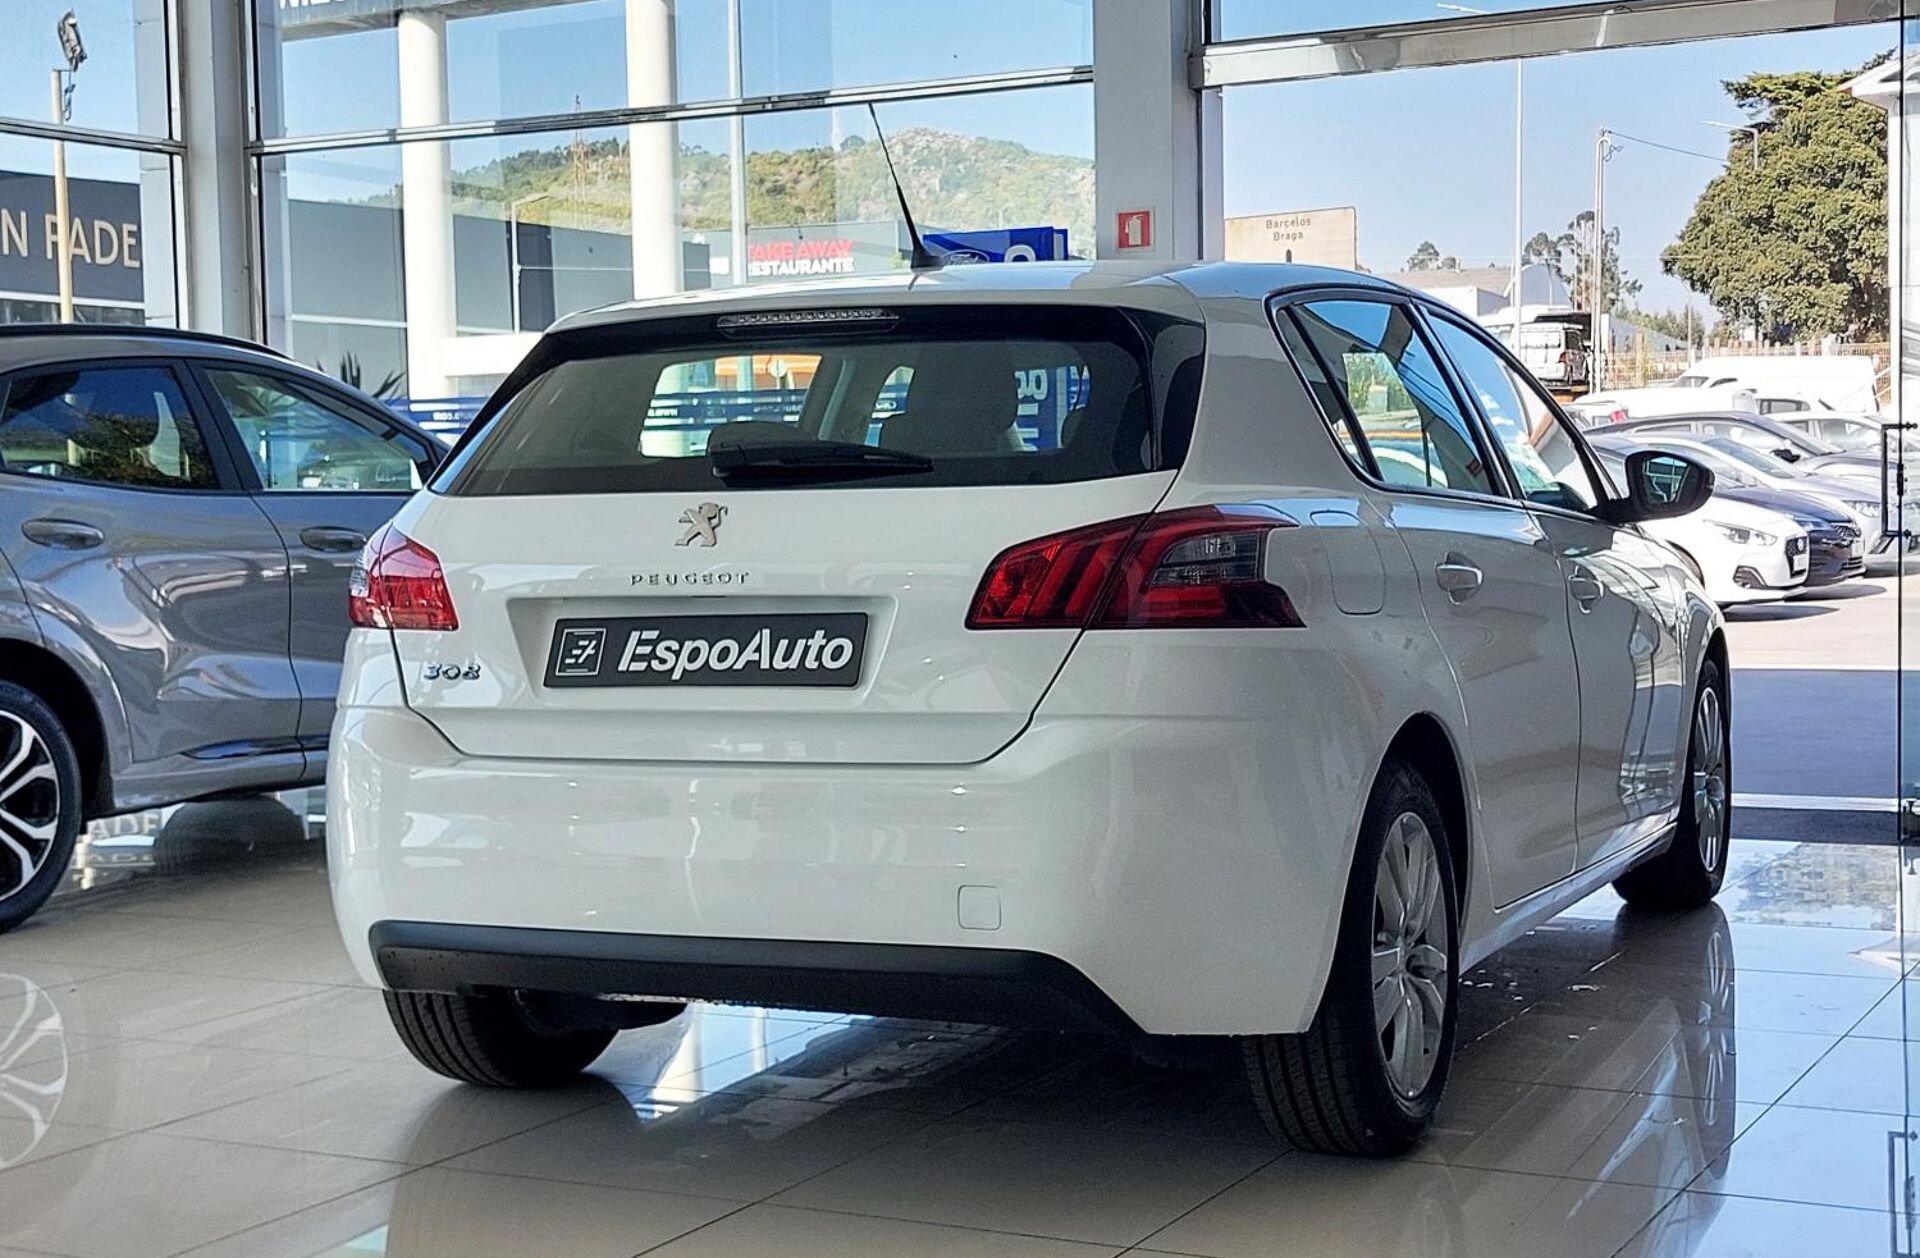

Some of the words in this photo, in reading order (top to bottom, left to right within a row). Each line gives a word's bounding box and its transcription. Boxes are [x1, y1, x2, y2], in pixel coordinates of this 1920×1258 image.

[1265, 217, 1311, 230] Barcelos
[1273, 231, 1303, 242] Braga
[797, 241, 855, 258] AWAY
[748, 257, 856, 277] ESTAURANTE
[630, 571, 750, 586] PEUGEOT
[617, 628, 853, 681] EspoAuto
[423, 663, 481, 681] 308
